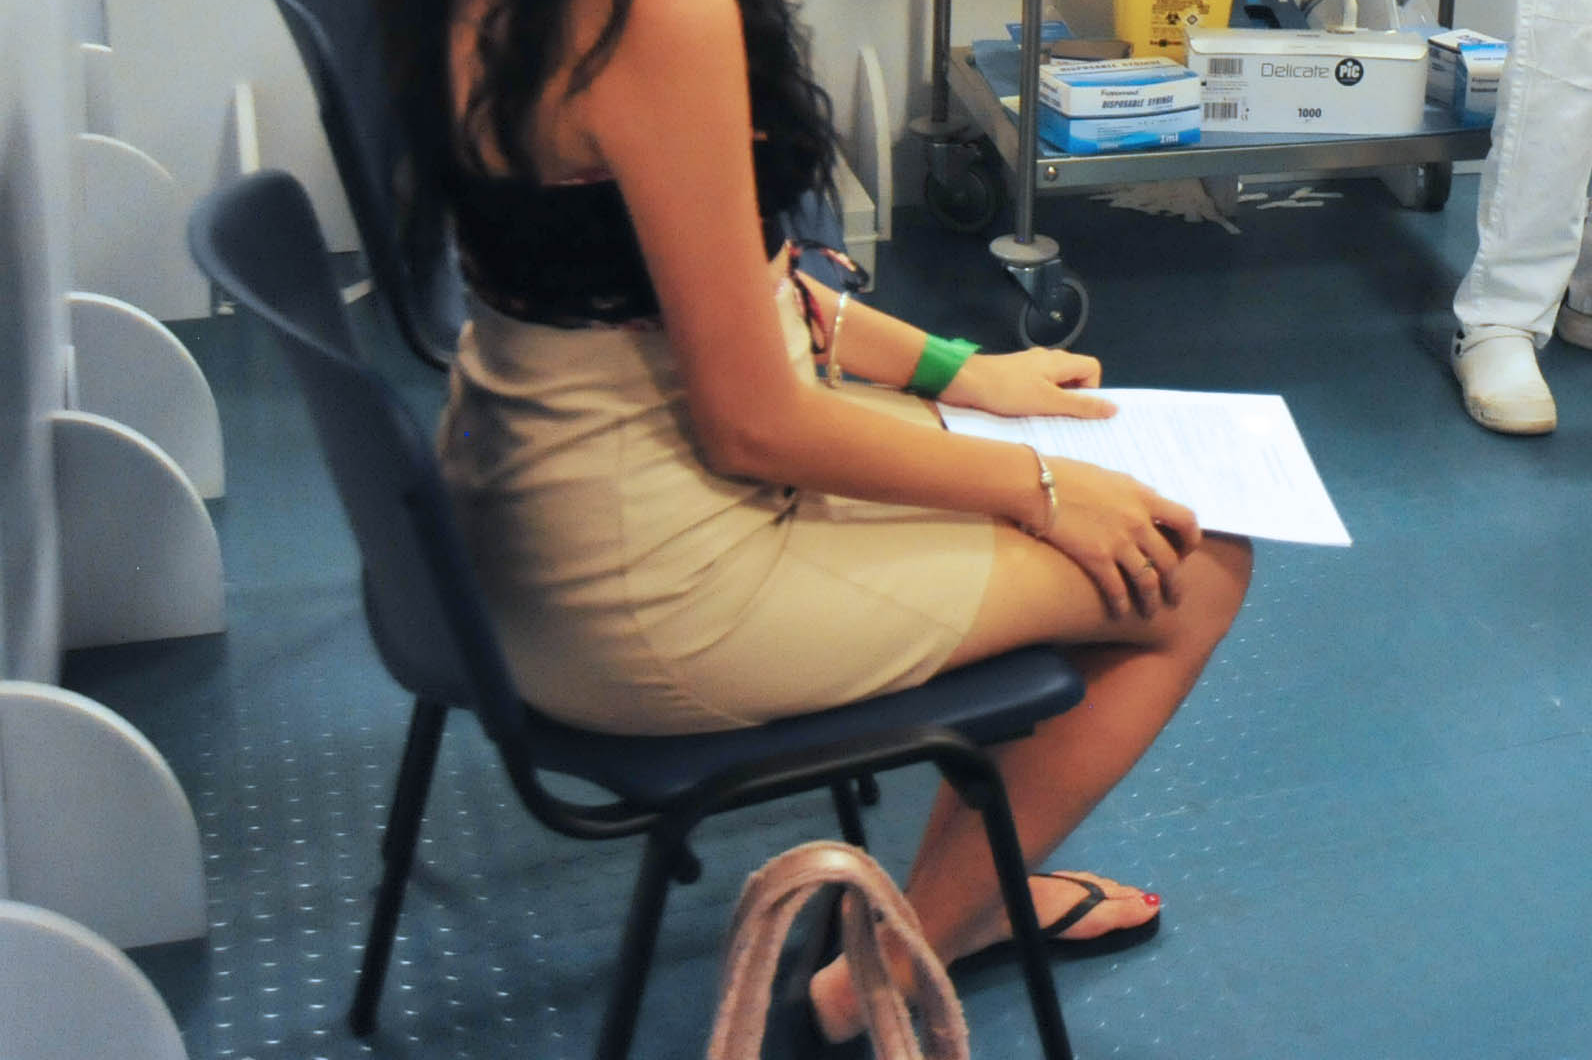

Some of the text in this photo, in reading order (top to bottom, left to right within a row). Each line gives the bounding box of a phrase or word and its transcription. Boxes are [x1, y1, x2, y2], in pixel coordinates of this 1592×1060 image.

[1260, 62, 1330, 78] Delicate
[1102, 95, 1174, 109] DISPOSABLE SYRINGE
[1298, 107, 1322, 118] 1000
